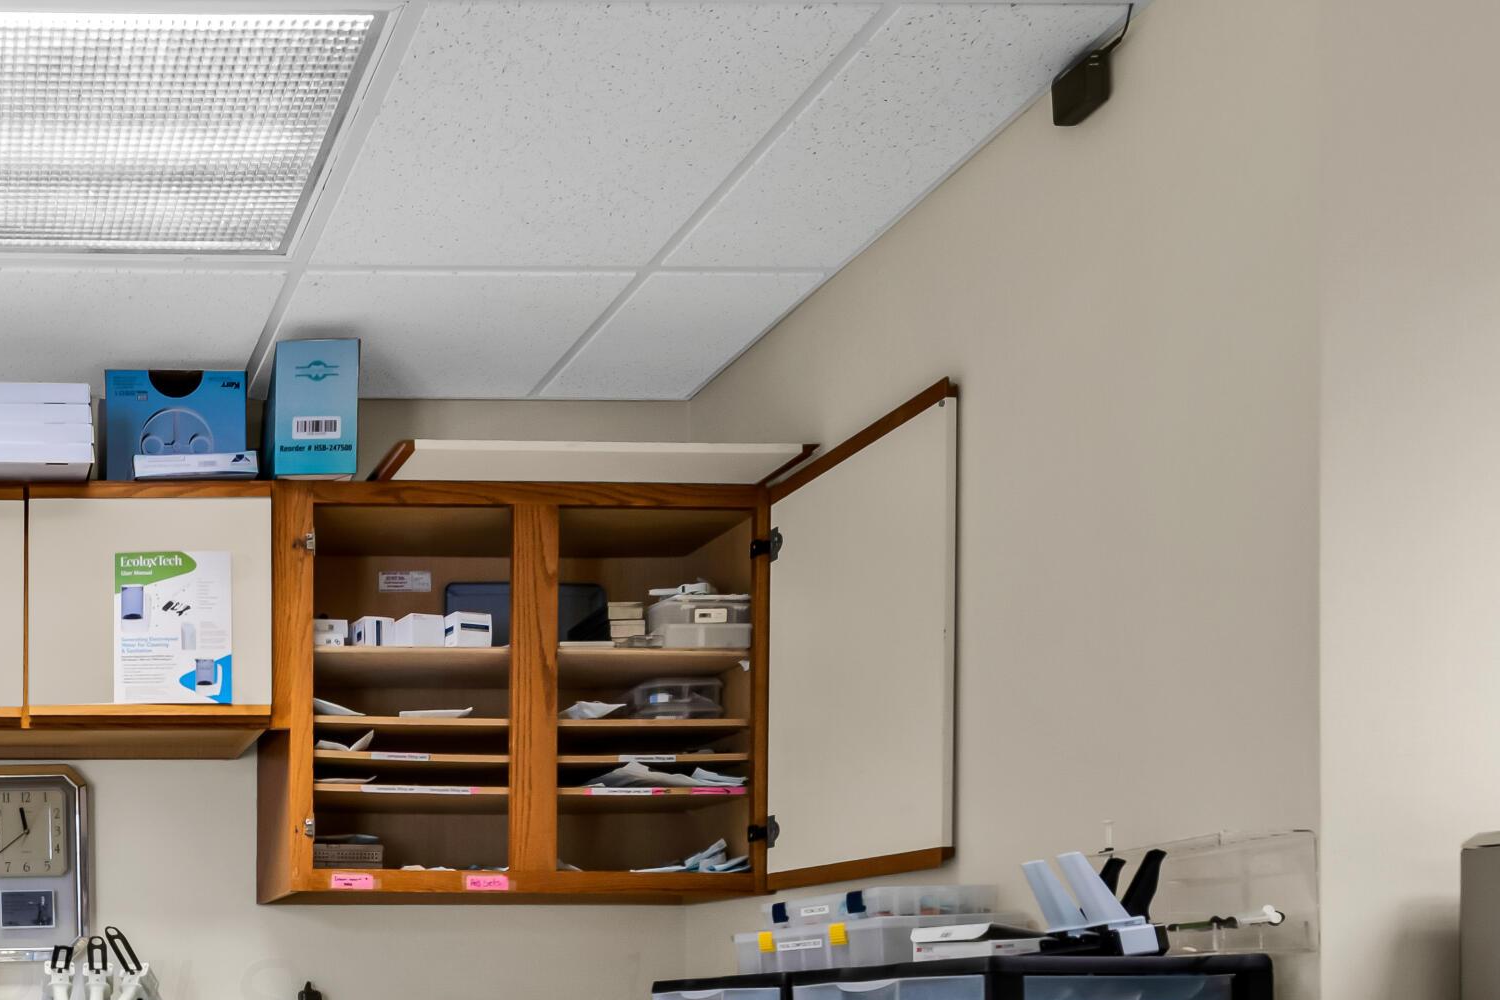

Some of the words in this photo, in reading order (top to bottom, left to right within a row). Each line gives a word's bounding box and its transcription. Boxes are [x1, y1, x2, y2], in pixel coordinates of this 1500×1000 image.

[279, 444, 306, 453] Reorder
[120, 554, 183, 568] EcoloxTech
[2, 792, 10, 803] 11
[20, 792, 31, 803] 12
[53, 808, 61, 819] 2
[54, 826, 62, 837] 3
[54, 844, 61, 854] 4
[4, 861, 11, 873] 7
[22, 861, 31, 873] 6
[44, 861, 52, 872] 5
